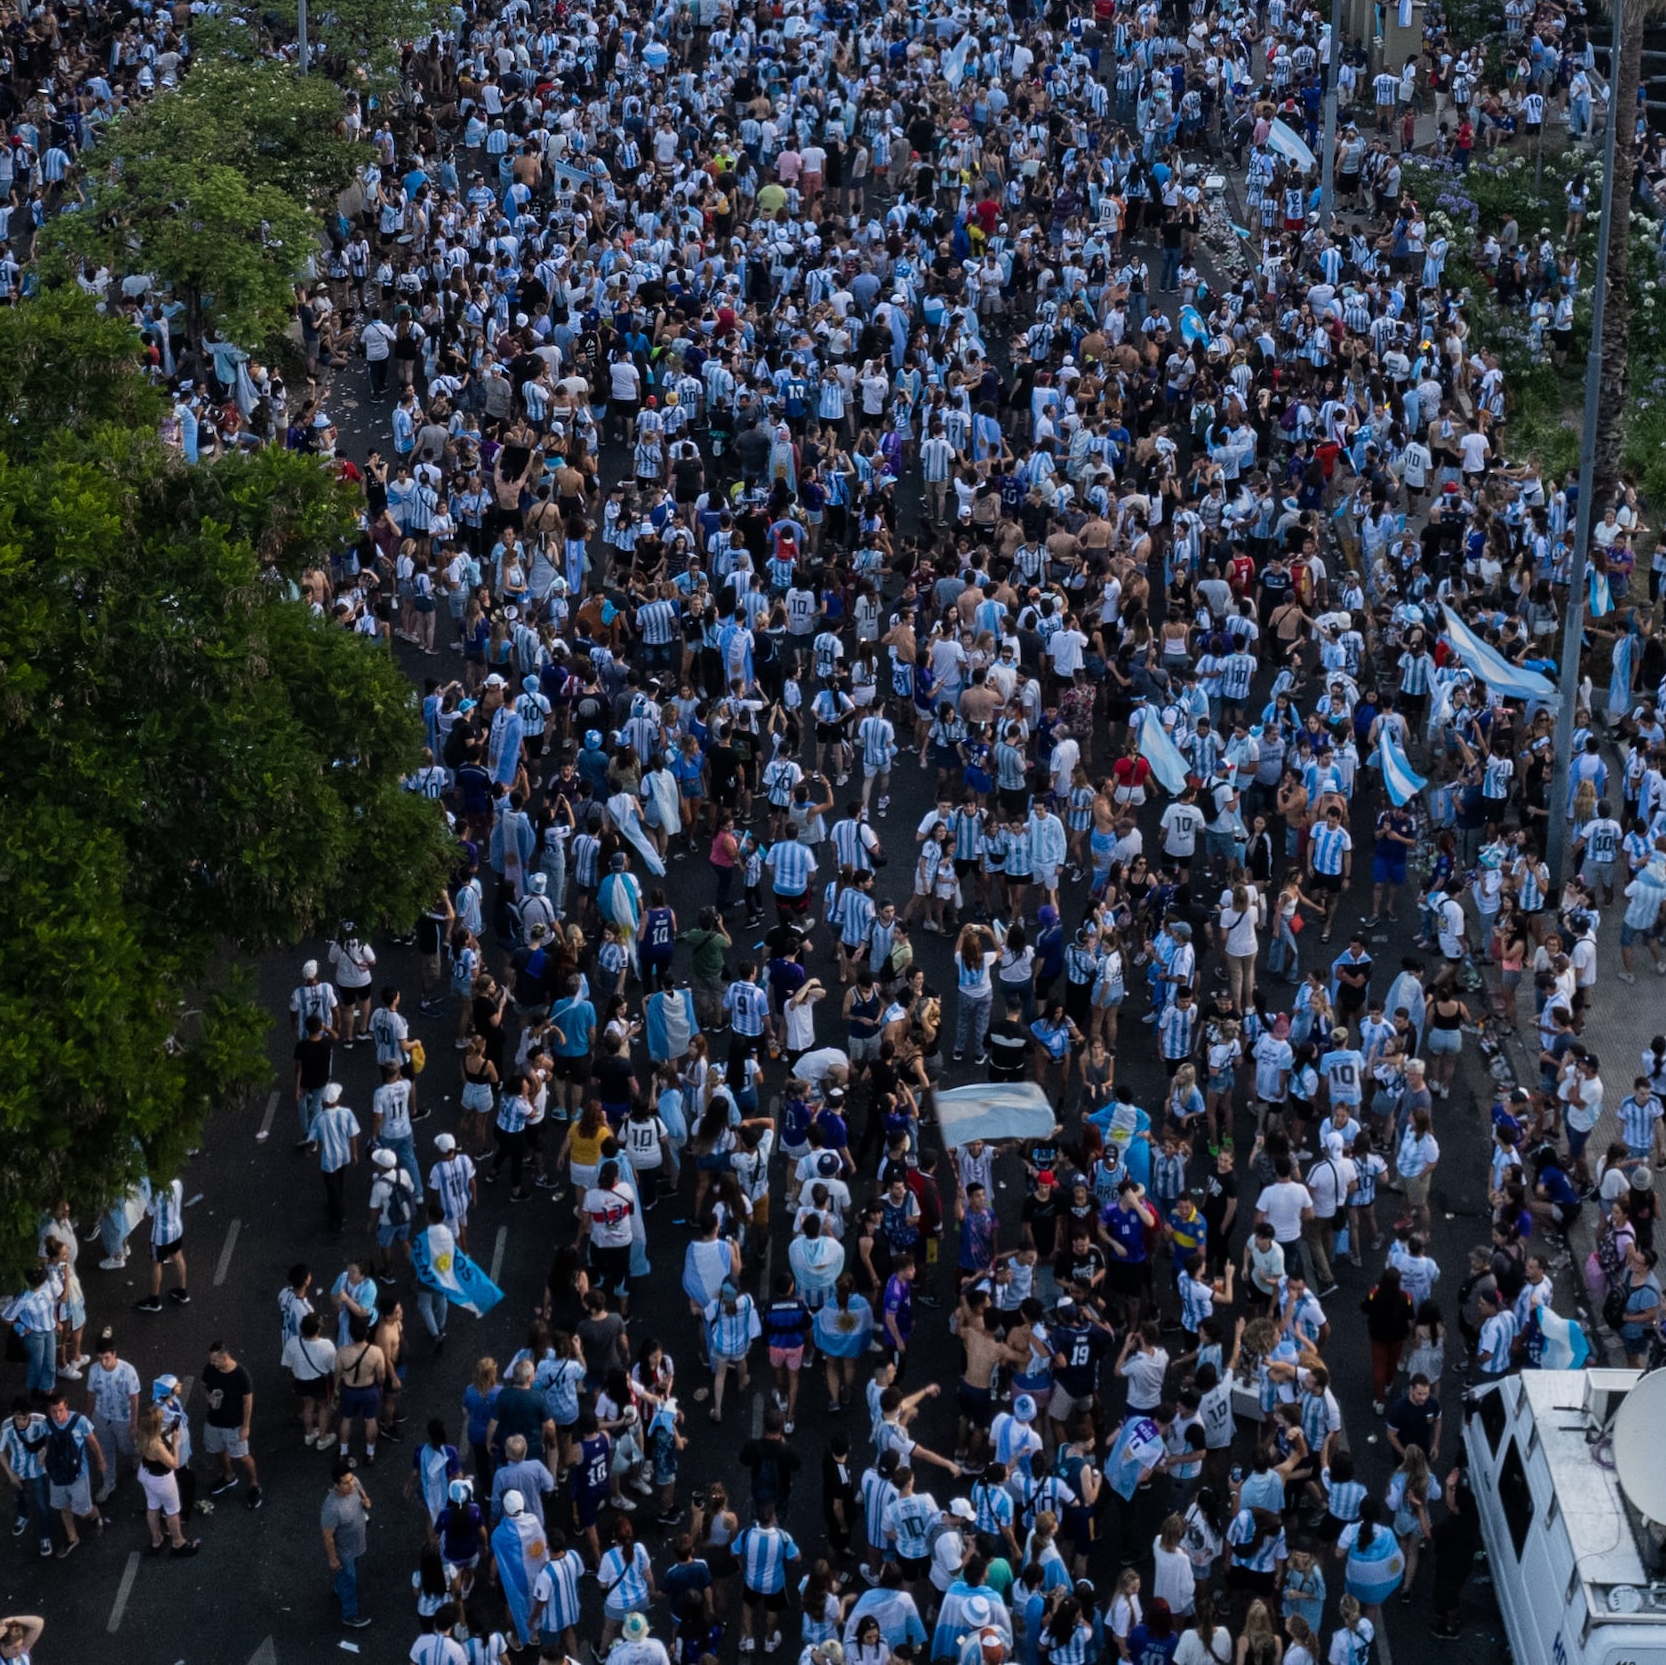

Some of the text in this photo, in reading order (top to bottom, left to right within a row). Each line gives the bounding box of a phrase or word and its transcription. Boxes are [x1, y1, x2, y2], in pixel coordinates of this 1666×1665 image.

[1530, 97, 1542, 109] 10
[1100, 204, 1111, 220] 10
[683, 390, 696, 404] 10
[1409, 450, 1420, 468] 10
[1001, 487, 1019, 505] 10
[791, 597, 807, 615] 10
[863, 604, 878, 621] 10
[818, 647, 833, 665] 10
[1234, 669, 1247, 685] 10
[522, 705, 540, 722] 10
[1174, 816, 1193, 832] 10
[1596, 835, 1612, 852] 10
[652, 927, 669, 946] 10
[737, 996, 747, 1015] 9
[1329, 1065, 1354, 1085] 10
[392, 1100, 403, 1119] 11
[632, 1128, 653, 1147] 10
[1069, 1344, 1091, 1367] 19
[1207, 1400, 1229, 1424] 10
[586, 1462, 608, 1487] 10
[901, 1516, 926, 1540] 10
[1139, 1651, 1165, 1665] 10
